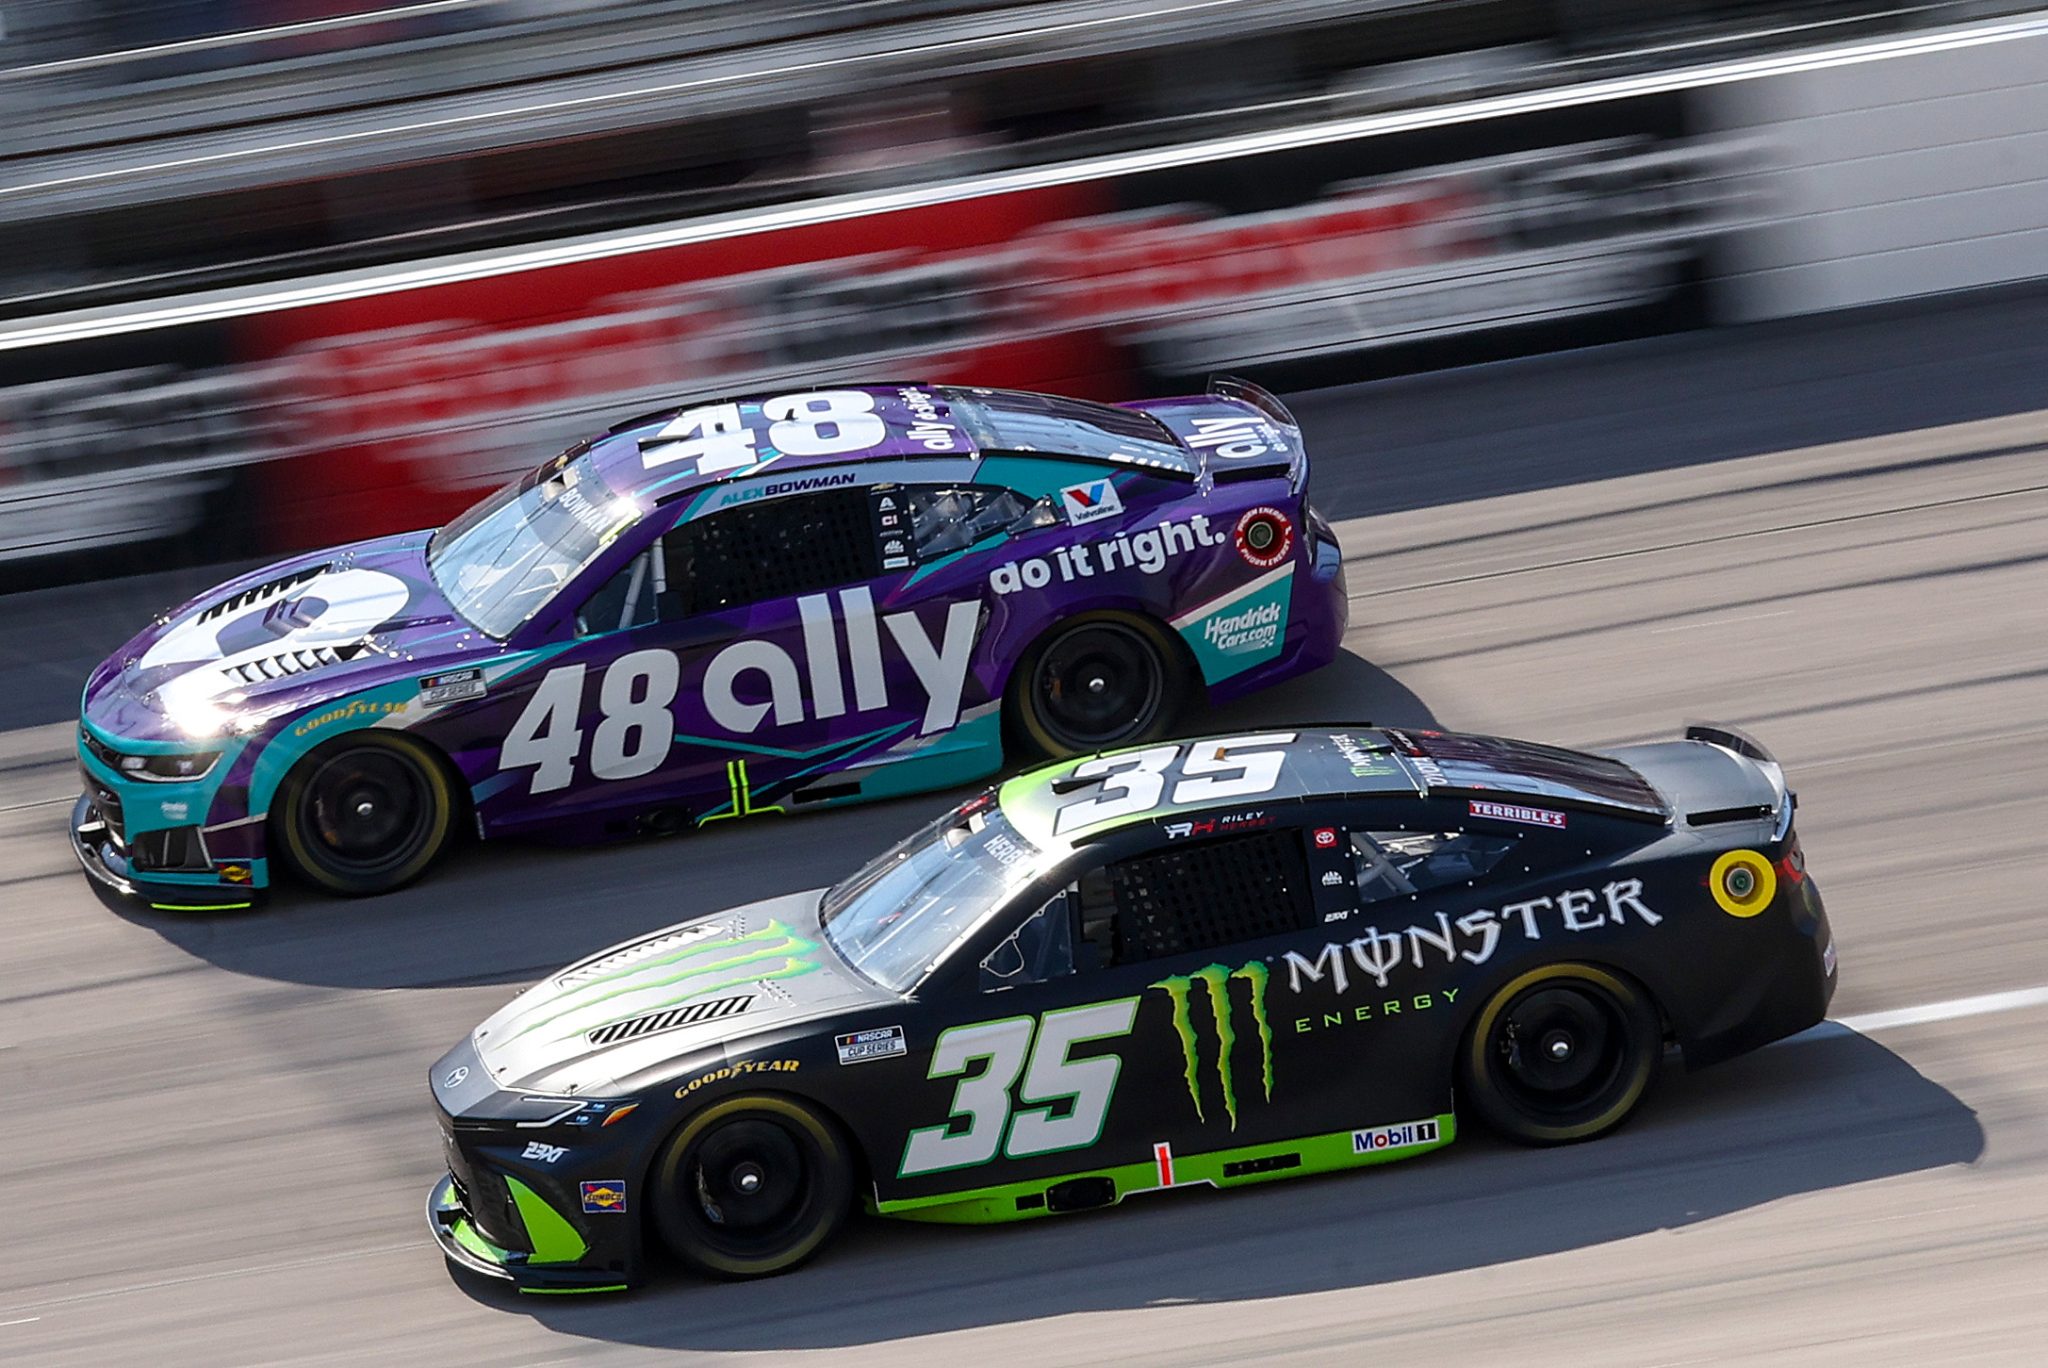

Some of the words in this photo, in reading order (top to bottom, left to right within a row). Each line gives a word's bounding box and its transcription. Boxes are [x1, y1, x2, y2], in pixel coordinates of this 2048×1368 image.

[642, 390, 885, 475] 48
[906, 421, 955, 450] ally
[1184, 417, 1267, 458] ally
[1075, 505, 1115, 520] Valvoline
[989, 558, 1051, 594] do
[1053, 544, 1094, 581] it
[1098, 514, 1226, 574] right.
[1204, 602, 1281, 643] Hendrick
[1217, 624, 1277, 650] Cars.com
[702, 585, 982, 735] ally
[294, 700, 409, 736] GOODYEAR
[498, 648, 680, 794] 48
[1053, 732, 1297, 836] 35
[1222, 811, 1264, 823] RILEY
[1472, 803, 1562, 824] TERRIBLE'S
[983, 834, 1026, 867] HERB
[1282, 877, 1664, 994] MONSTER
[1295, 988, 1460, 1033] ENERGY
[848, 1045, 865, 1056] CUP
[866, 1041, 896, 1054] SERIES
[856, 1029, 893, 1044] NASCAR
[674, 1058, 800, 1100] GOODYEAR
[897, 995, 1142, 1179] 35
[1355, 1126, 1413, 1150] Mobil
